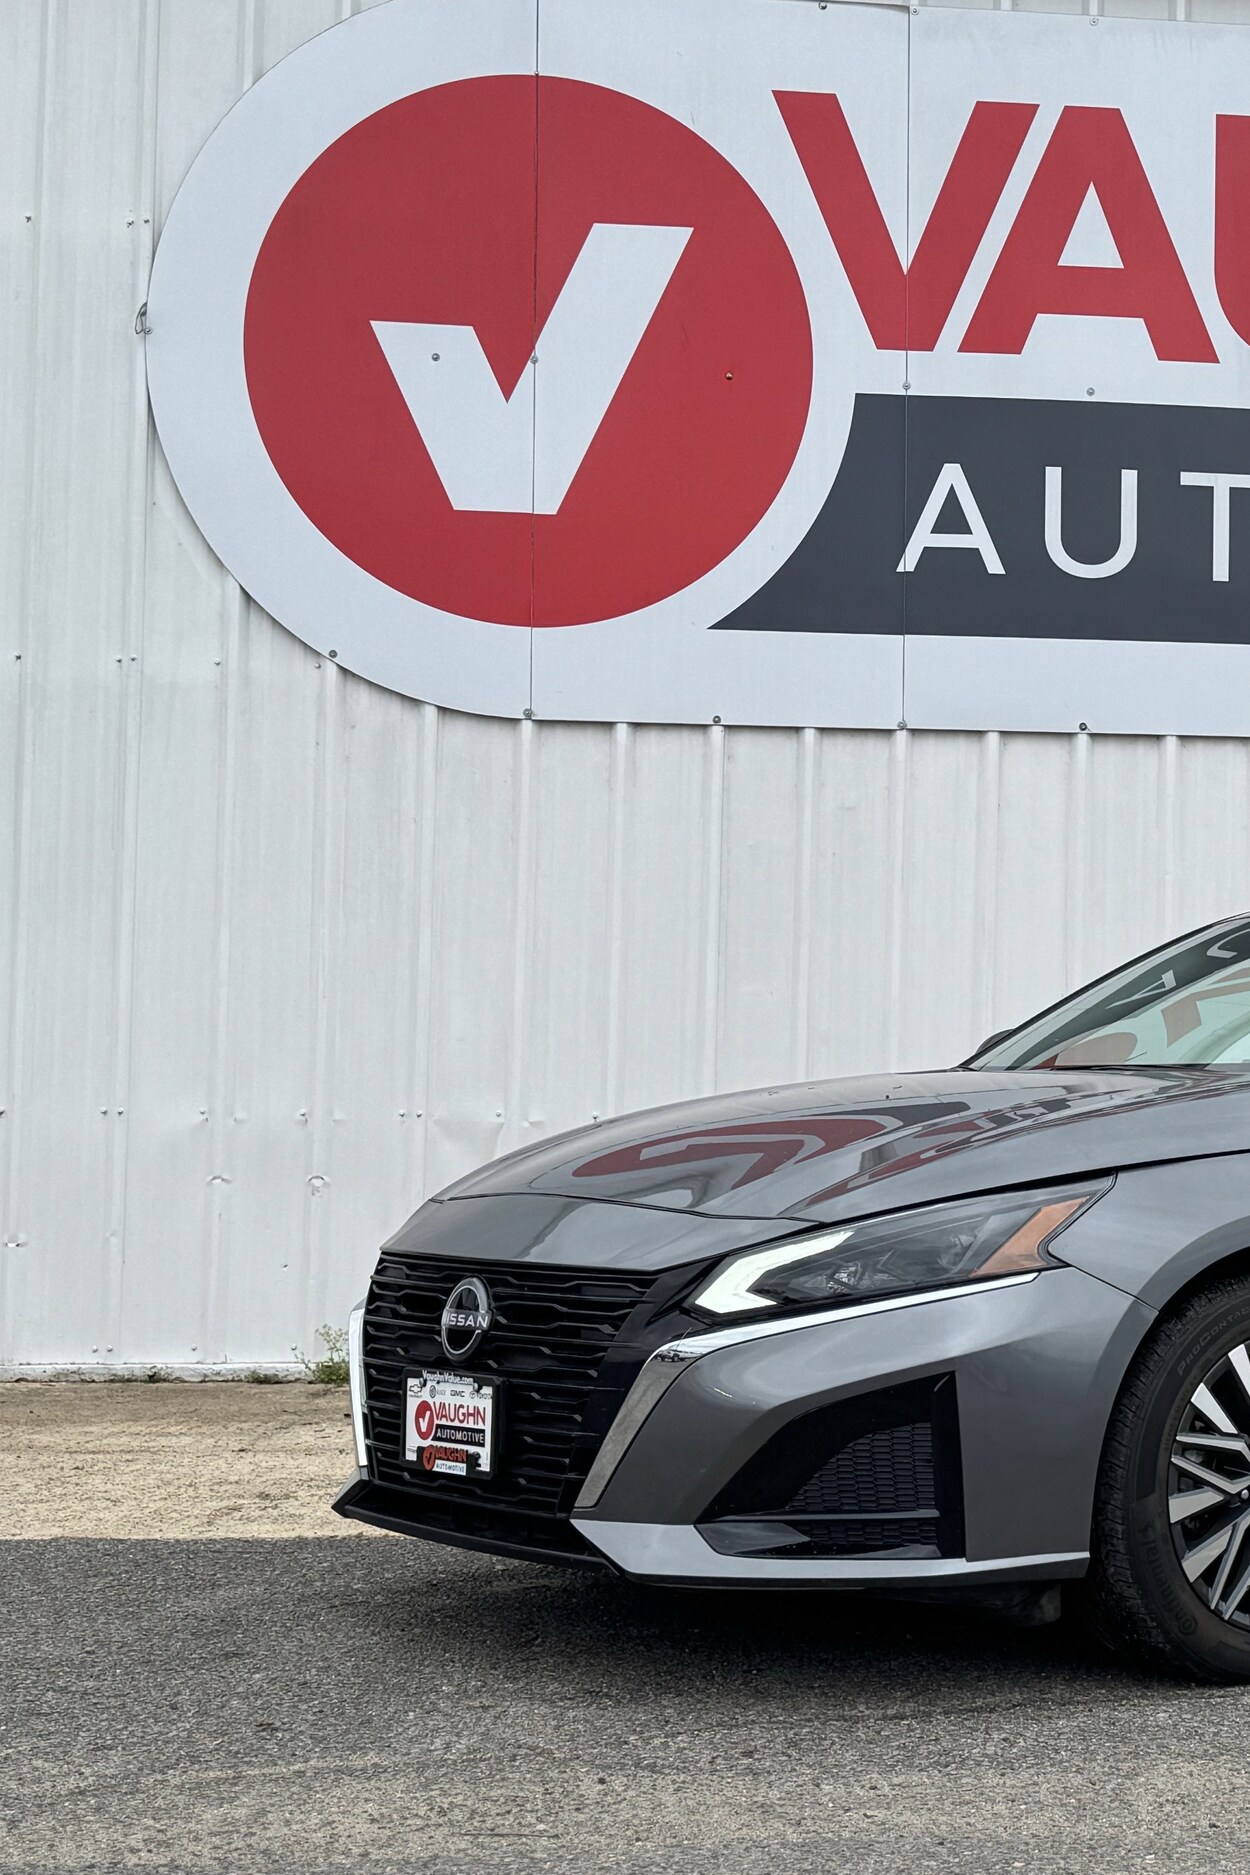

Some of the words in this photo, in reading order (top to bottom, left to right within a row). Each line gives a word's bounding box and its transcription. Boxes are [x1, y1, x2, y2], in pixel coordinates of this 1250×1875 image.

[422, 1369, 474, 1385] VaughnValue.com
[450, 1389, 466, 1398] GMC
[433, 1401, 486, 1426] VAUGHN
[436, 1428, 485, 1443] AUTOMOTIVE
[435, 1446, 467, 1463] VAUGHN
